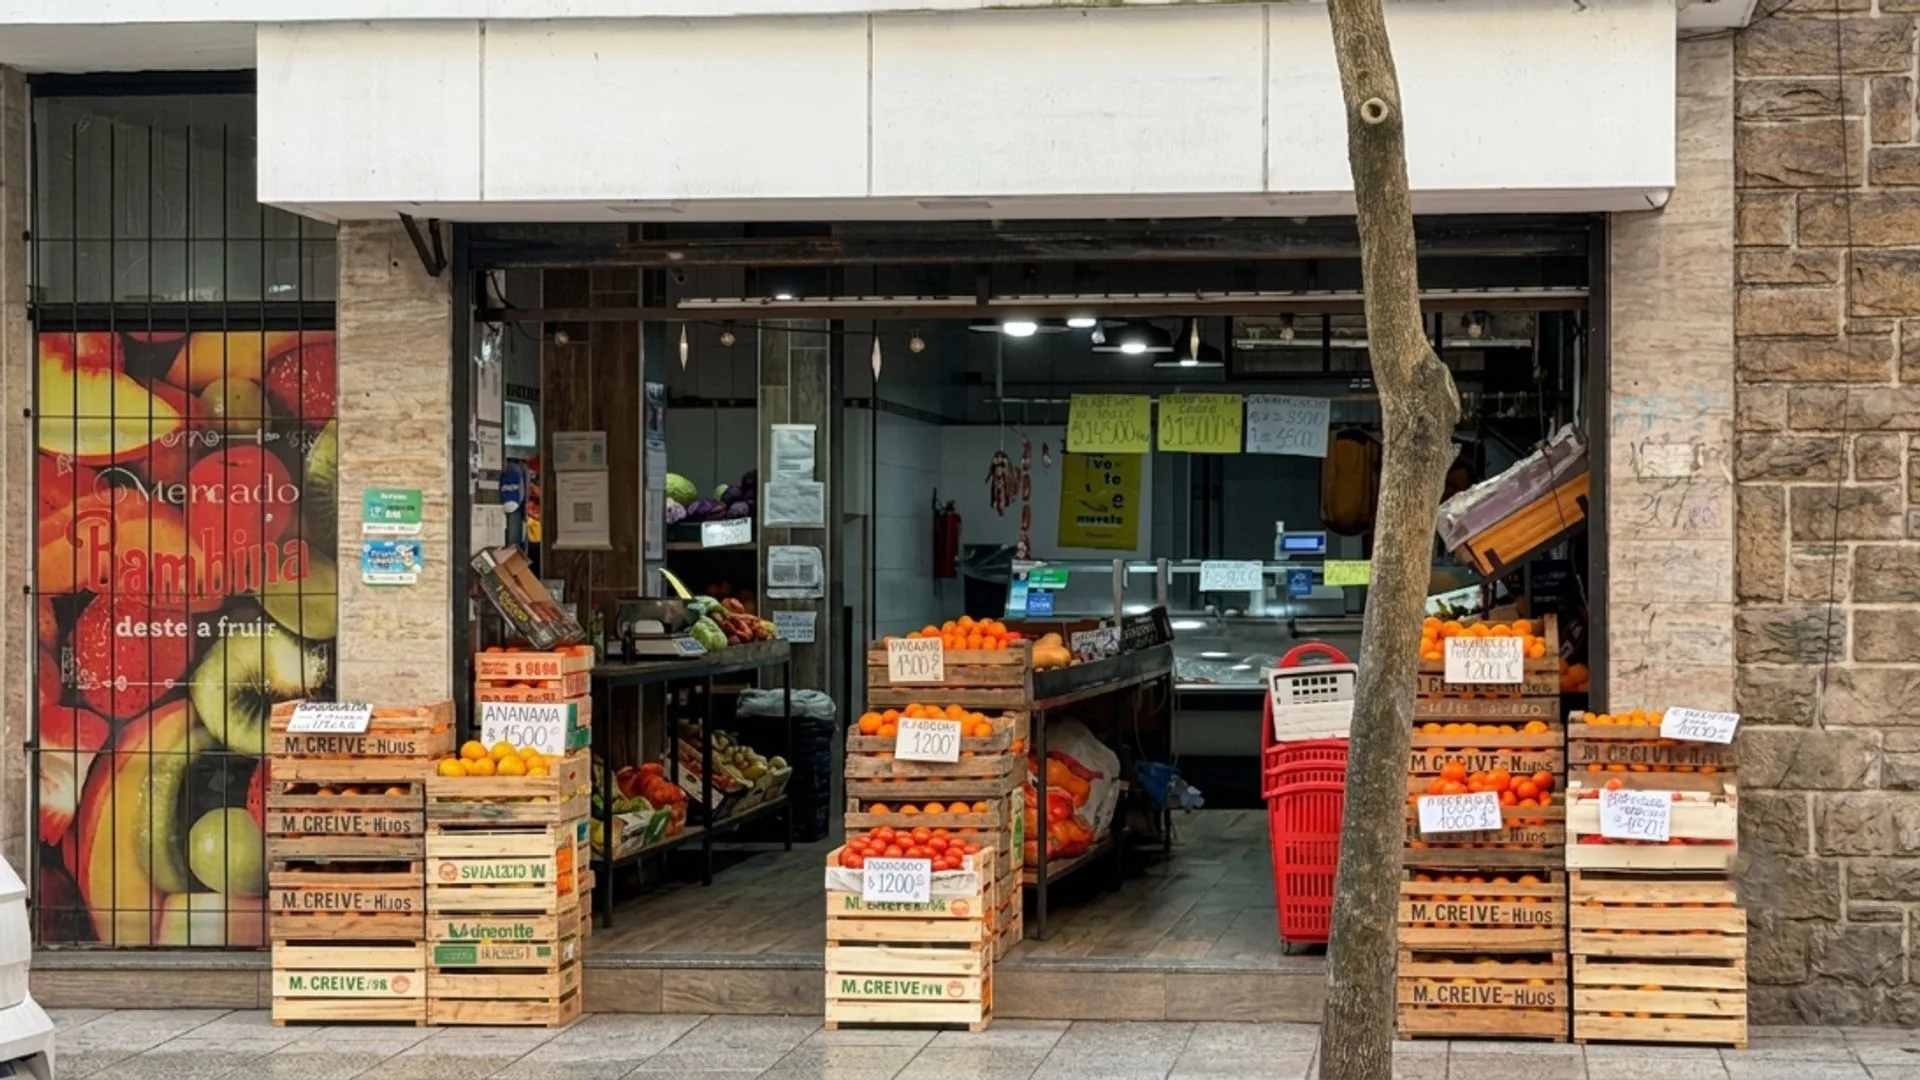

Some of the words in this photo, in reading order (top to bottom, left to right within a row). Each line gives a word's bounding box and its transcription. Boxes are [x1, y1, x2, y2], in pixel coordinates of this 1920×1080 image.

[94, 467, 300, 504] Mercado
[65, 508, 310, 605] Bambina
[197, 624, 211, 637] a
[485, 706, 561, 722] ANANANA
